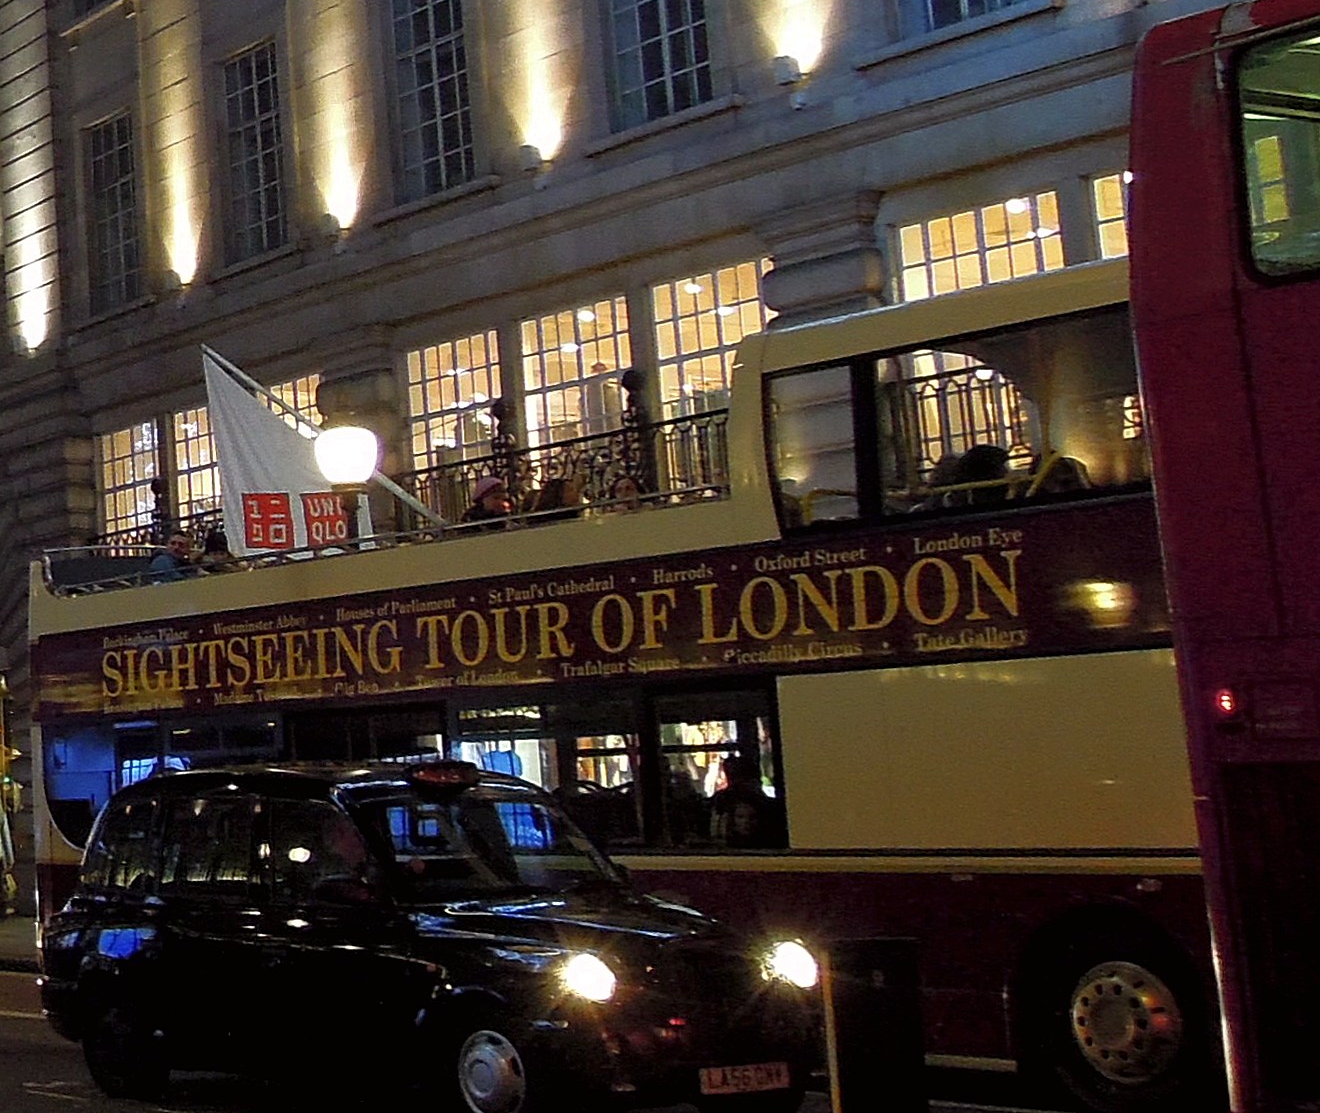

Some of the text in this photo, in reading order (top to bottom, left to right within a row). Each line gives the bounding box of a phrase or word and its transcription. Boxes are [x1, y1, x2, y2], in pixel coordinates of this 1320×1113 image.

[307, 495, 343, 517] UNI
[312, 519, 346, 544] QLO
[214, 619, 273, 636] Westminster
[276, 614, 308, 631] Abbey
[336, 605, 375, 622] Houses
[377, 603, 391, 618] of
[391, 596, 457, 616] Parliament
[488, 588, 503, 605] St
[505, 583, 545, 602] Paul's
[546, 574, 615, 597] Cathedral
[652, 563, 714, 585] Harrods
[754, 550, 810, 572] Oxford
[814, 547, 867, 566] Street
[913, 532, 983, 555] London
[988, 526, 1024, 548] Eye
[101, 549, 1022, 698] SIGHTSEEING TOUR OF LONDON
[357, 679, 379, 695] Ben
[415, 674, 455, 689] Tower
[455, 671, 469, 686] of
[469, 668, 519, 684] London
[560, 659, 626, 679] Trafalgar
[627, 655, 680, 674] Square
[723, 643, 802, 665] Piccadilly
[808, 640, 863, 659] Circus
[913, 632, 956, 652] Tate
[958, 626, 1029, 647] Gallery
